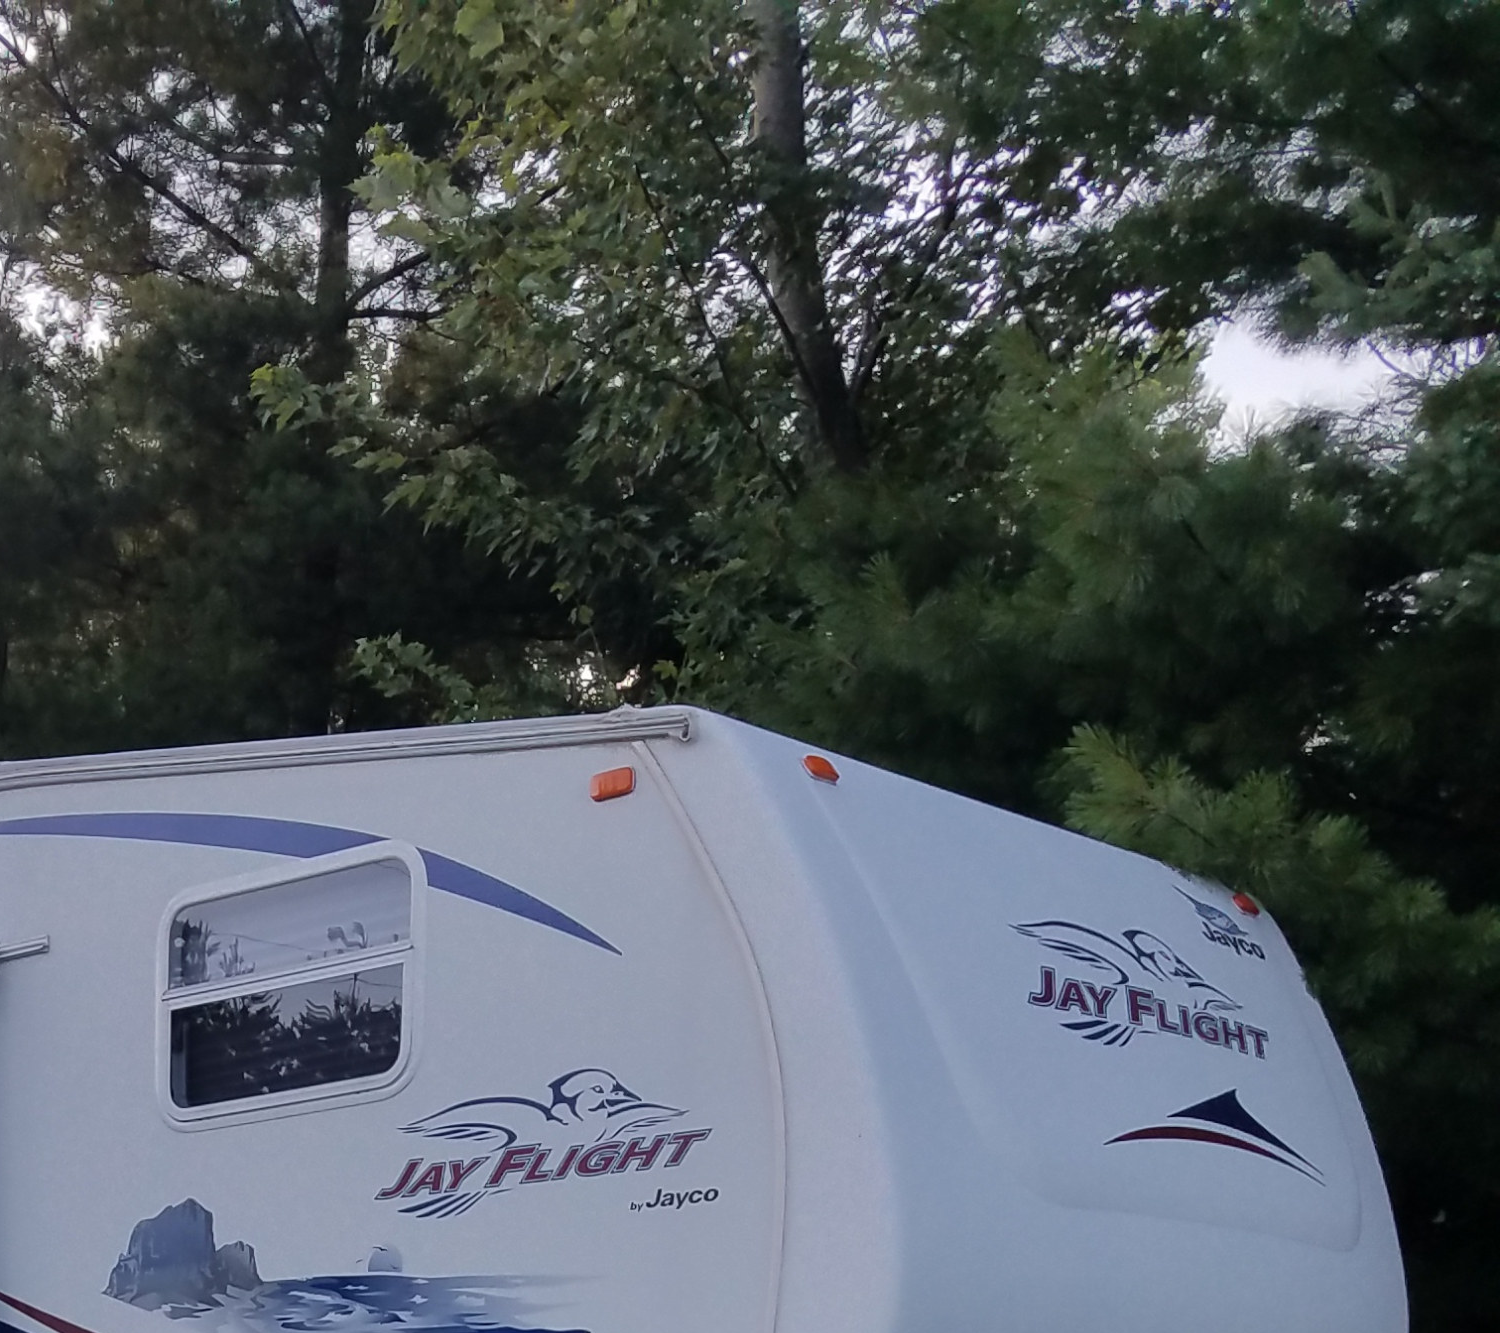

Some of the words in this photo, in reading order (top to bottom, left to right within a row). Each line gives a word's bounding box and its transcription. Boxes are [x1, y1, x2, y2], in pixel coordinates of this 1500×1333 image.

[1202, 921, 1266, 960] Jayco
[1028, 966, 1117, 1018] JAY
[1125, 985, 1269, 1060] FLIGHT
[374, 1156, 490, 1200] JAY
[484, 1128, 712, 1189] FLIGHT
[630, 1201, 644, 1212] by
[645, 1188, 719, 1210] Jayco
